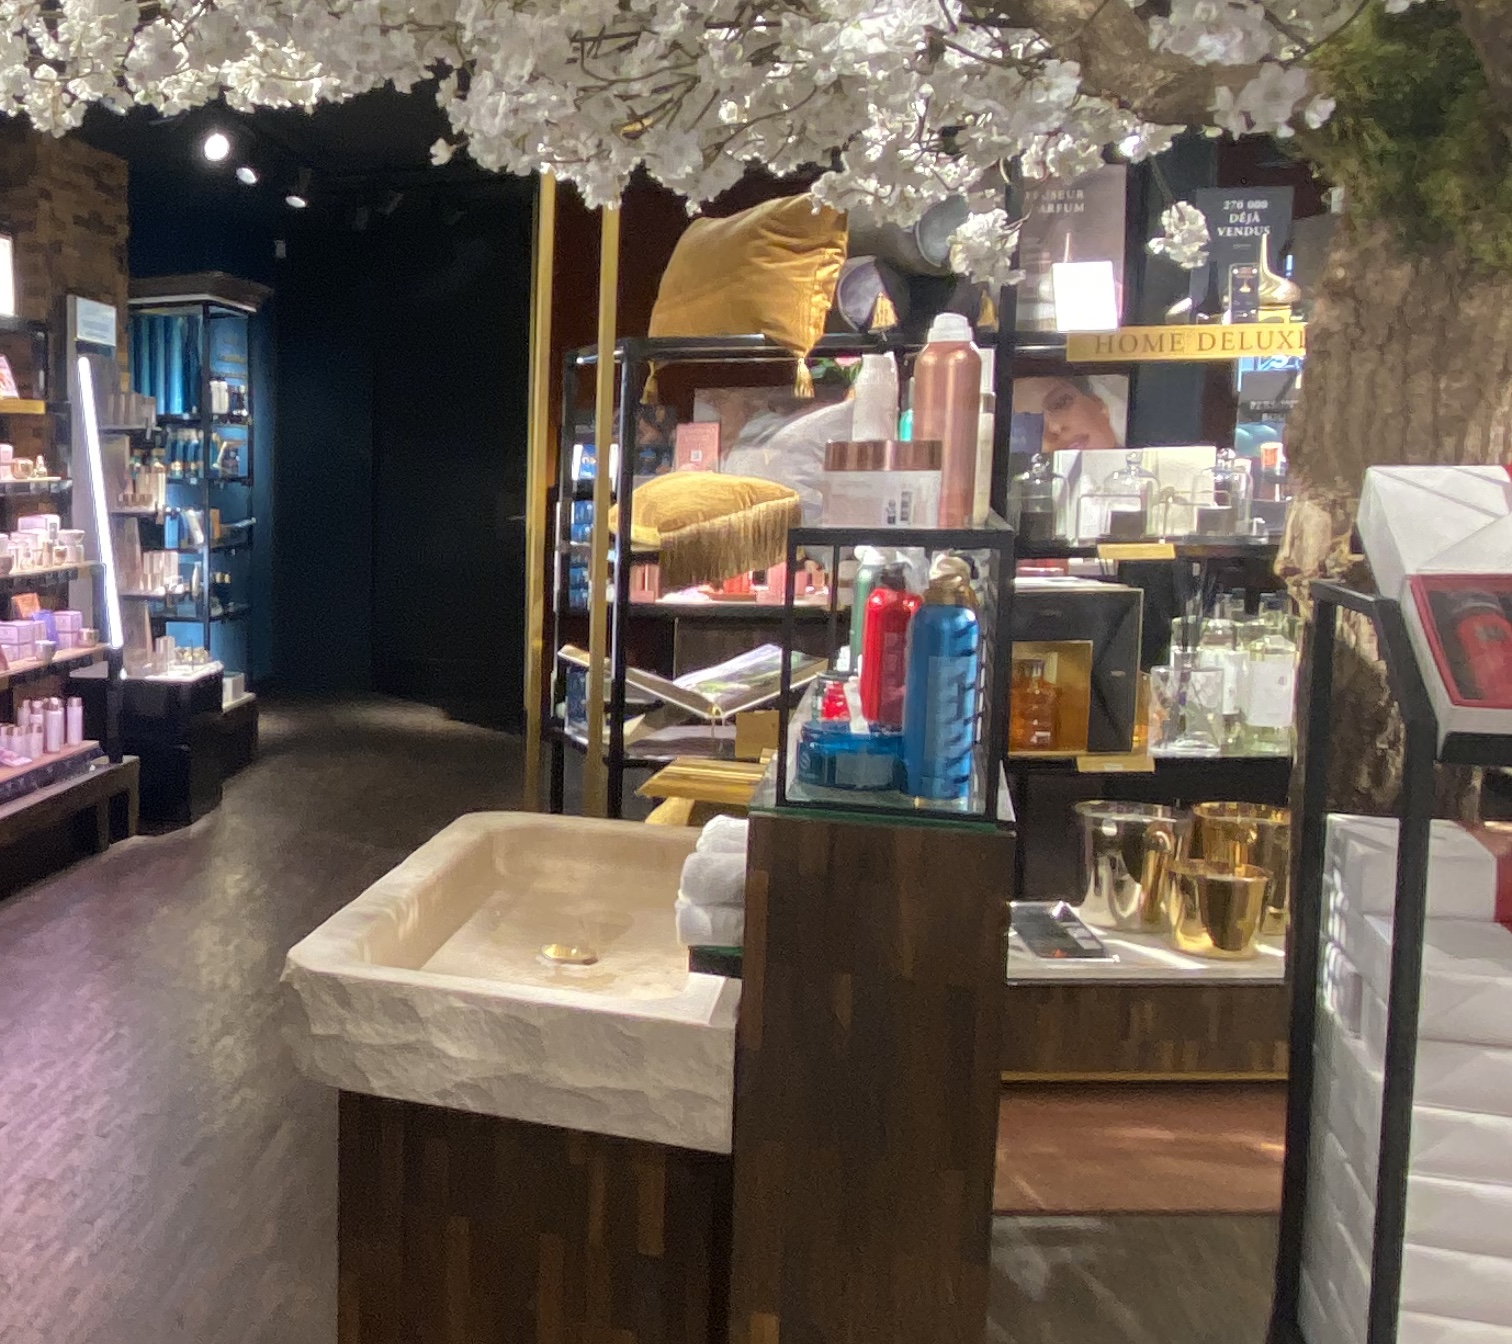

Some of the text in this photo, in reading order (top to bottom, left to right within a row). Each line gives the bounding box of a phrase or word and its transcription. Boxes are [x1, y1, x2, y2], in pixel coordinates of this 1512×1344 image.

[1229, 211, 1261, 224] DÉJÀ
[1217, 225, 1271, 237] VENDUS
[1095, 332, 1184, 355] HOME
